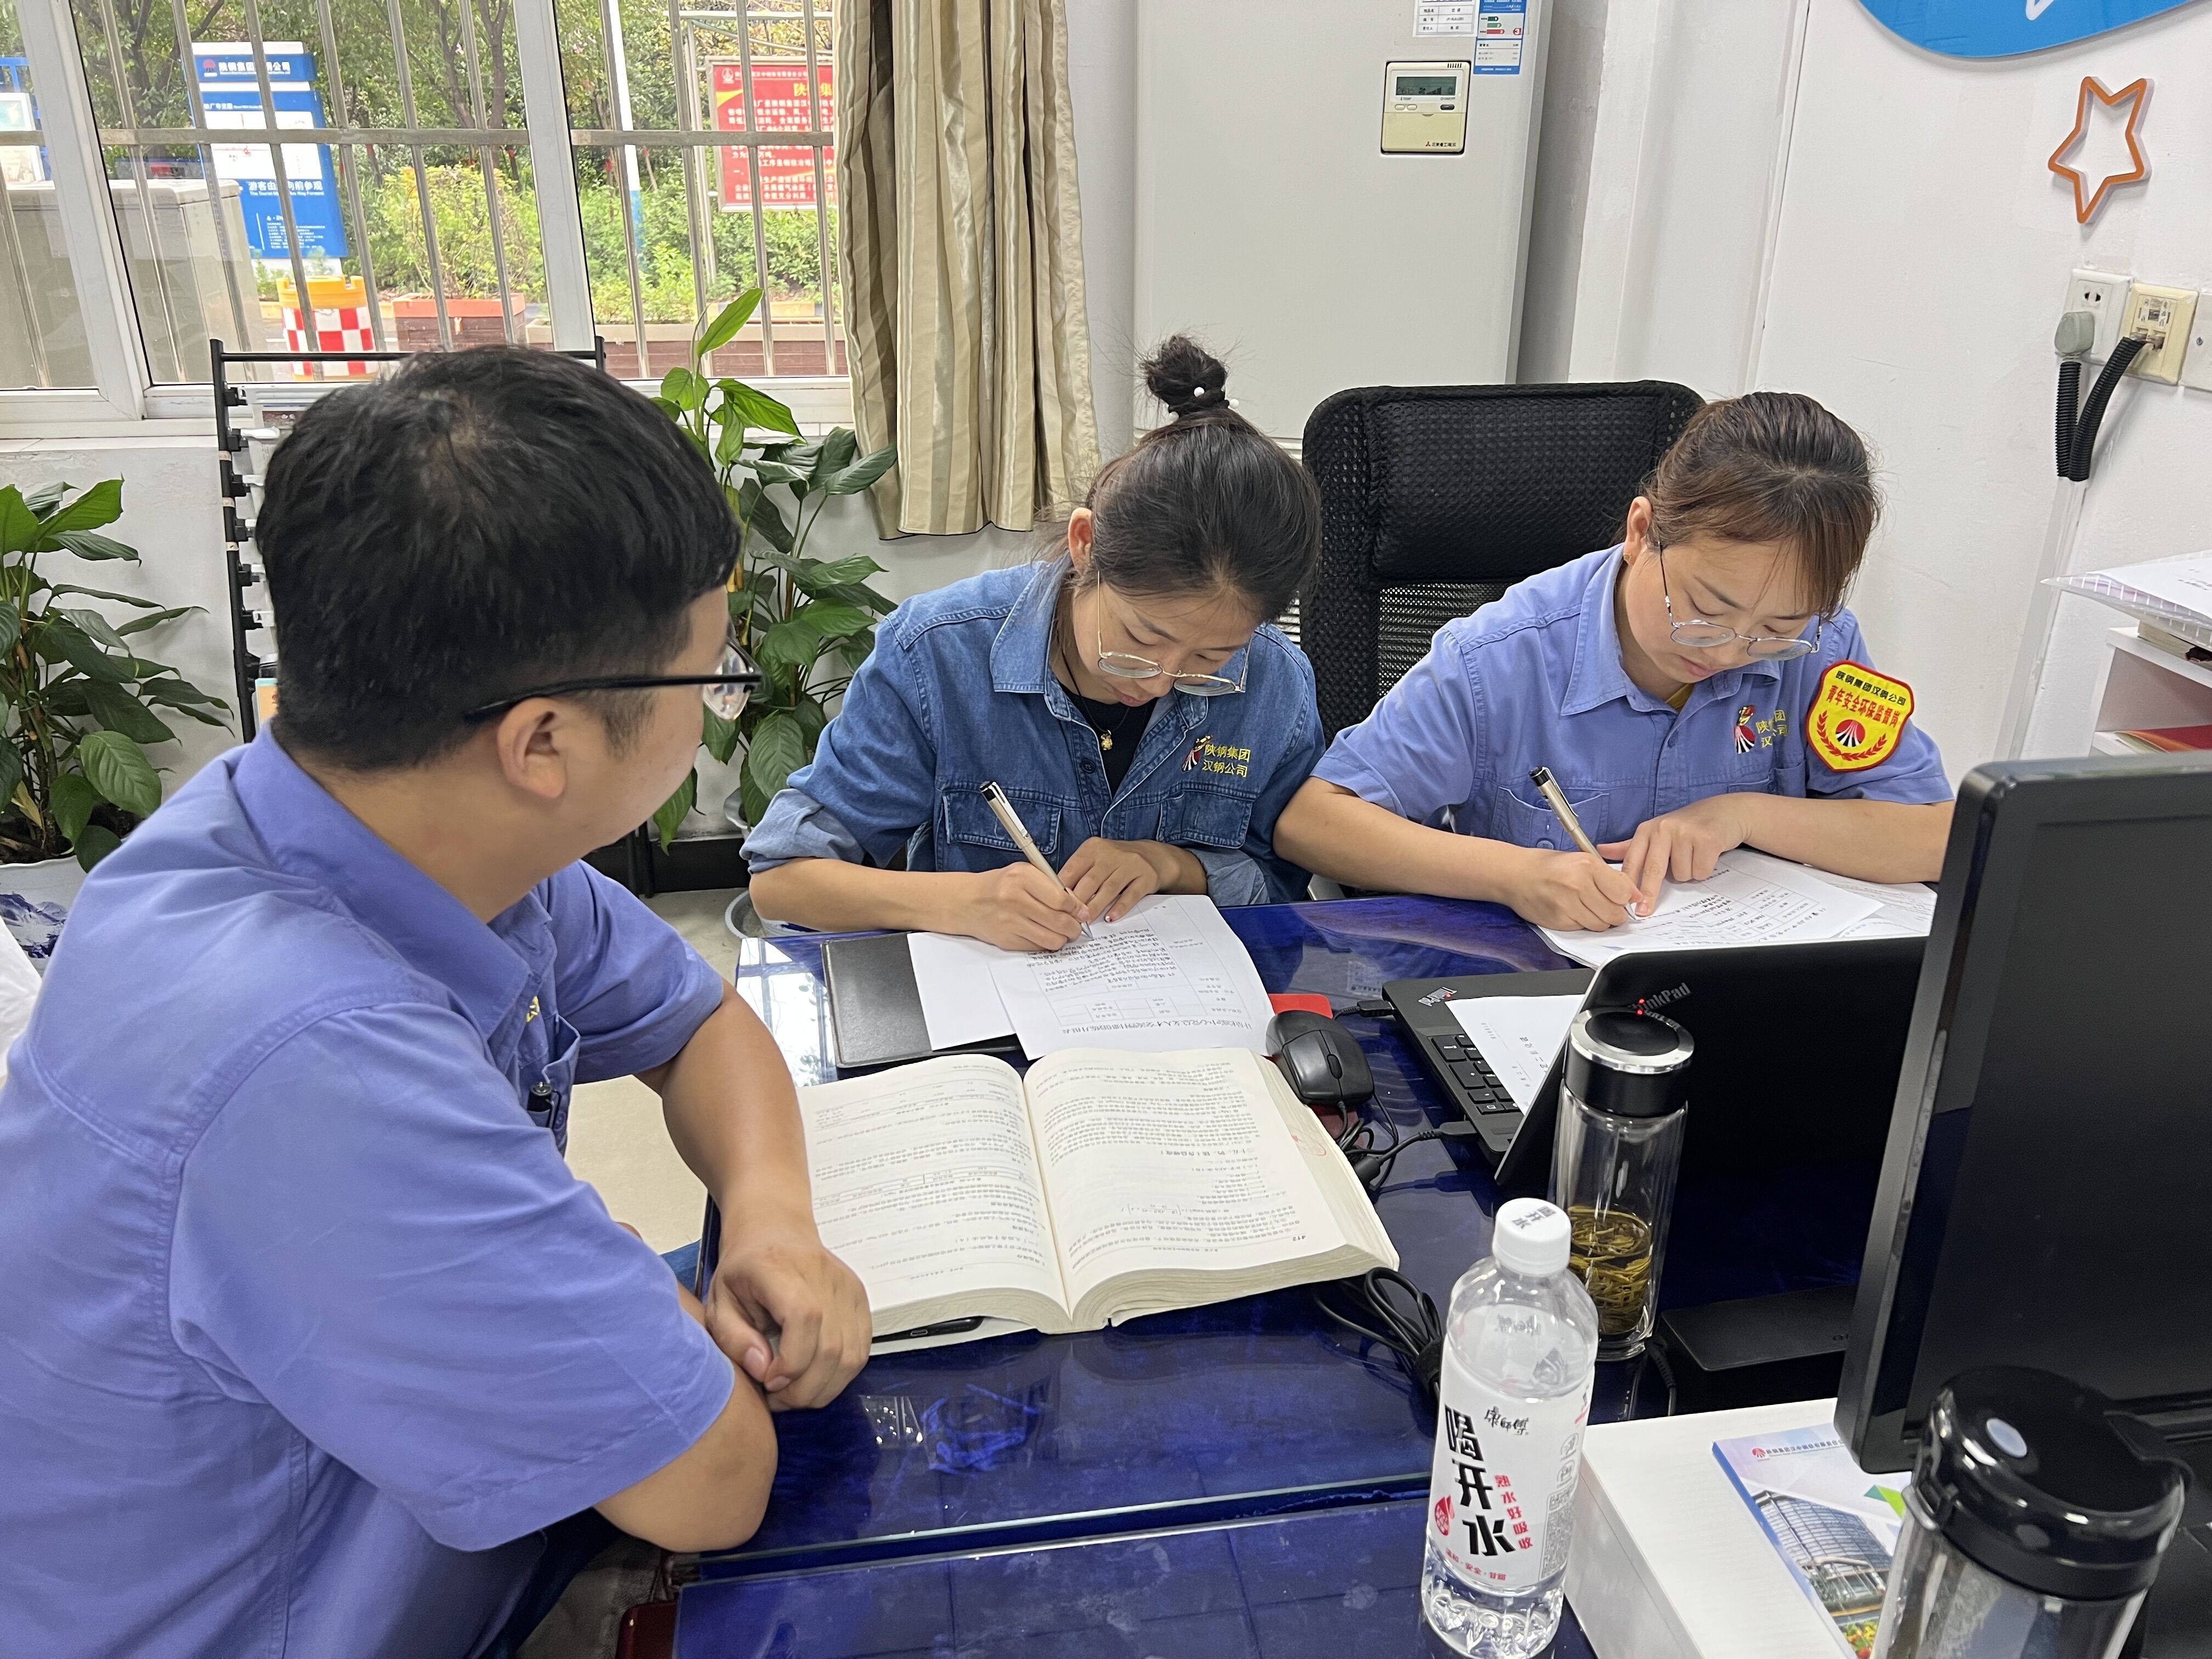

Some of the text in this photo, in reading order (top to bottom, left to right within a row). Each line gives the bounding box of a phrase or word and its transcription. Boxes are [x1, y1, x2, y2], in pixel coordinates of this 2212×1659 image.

[218, 61, 291, 72] 陕钢集团钢公司
[793, 83, 833, 97] 陕集
[249, 181, 323, 190] 游客由向前参观
[1836, 670, 1906, 706] 陕钢集团汉钢公司
[1826, 685, 1900, 727] 青年安全环保监督岗
[1204, 743, 1251, 762] 陕钢集团
[1202, 759, 1248, 777] 汉钢公司
[1512, 1206, 1556, 1229] 喝开水
[1444, 1403, 1516, 1556] 喝开水
[1494, 1475, 1533, 1549] 熟水好吸收
